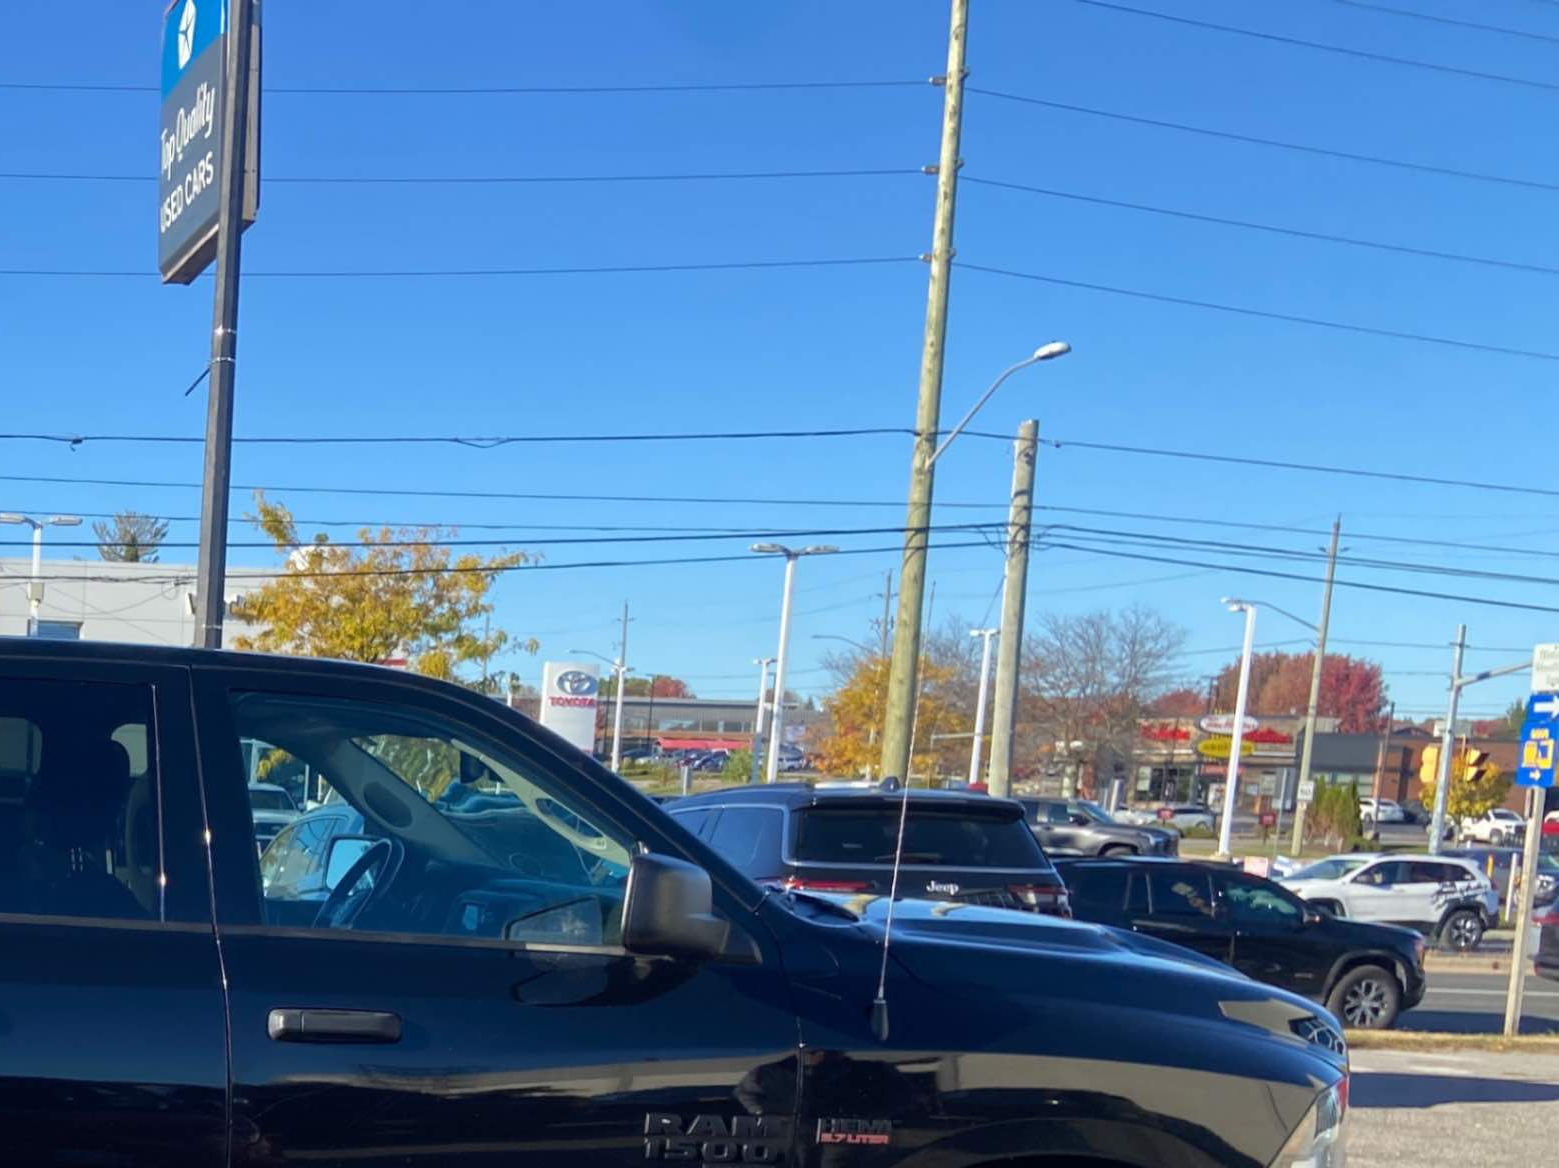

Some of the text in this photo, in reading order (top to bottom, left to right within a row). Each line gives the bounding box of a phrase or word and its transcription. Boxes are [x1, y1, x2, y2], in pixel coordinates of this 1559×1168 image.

[160, 82, 215, 181] Top Quality
[160, 151, 213, 232] USED CARS
[550, 696, 595, 707] TOYOTA
[926, 880, 959, 895] Jeep
[644, 1112, 778, 1137] RAM
[644, 1138, 778, 1161] 1500
